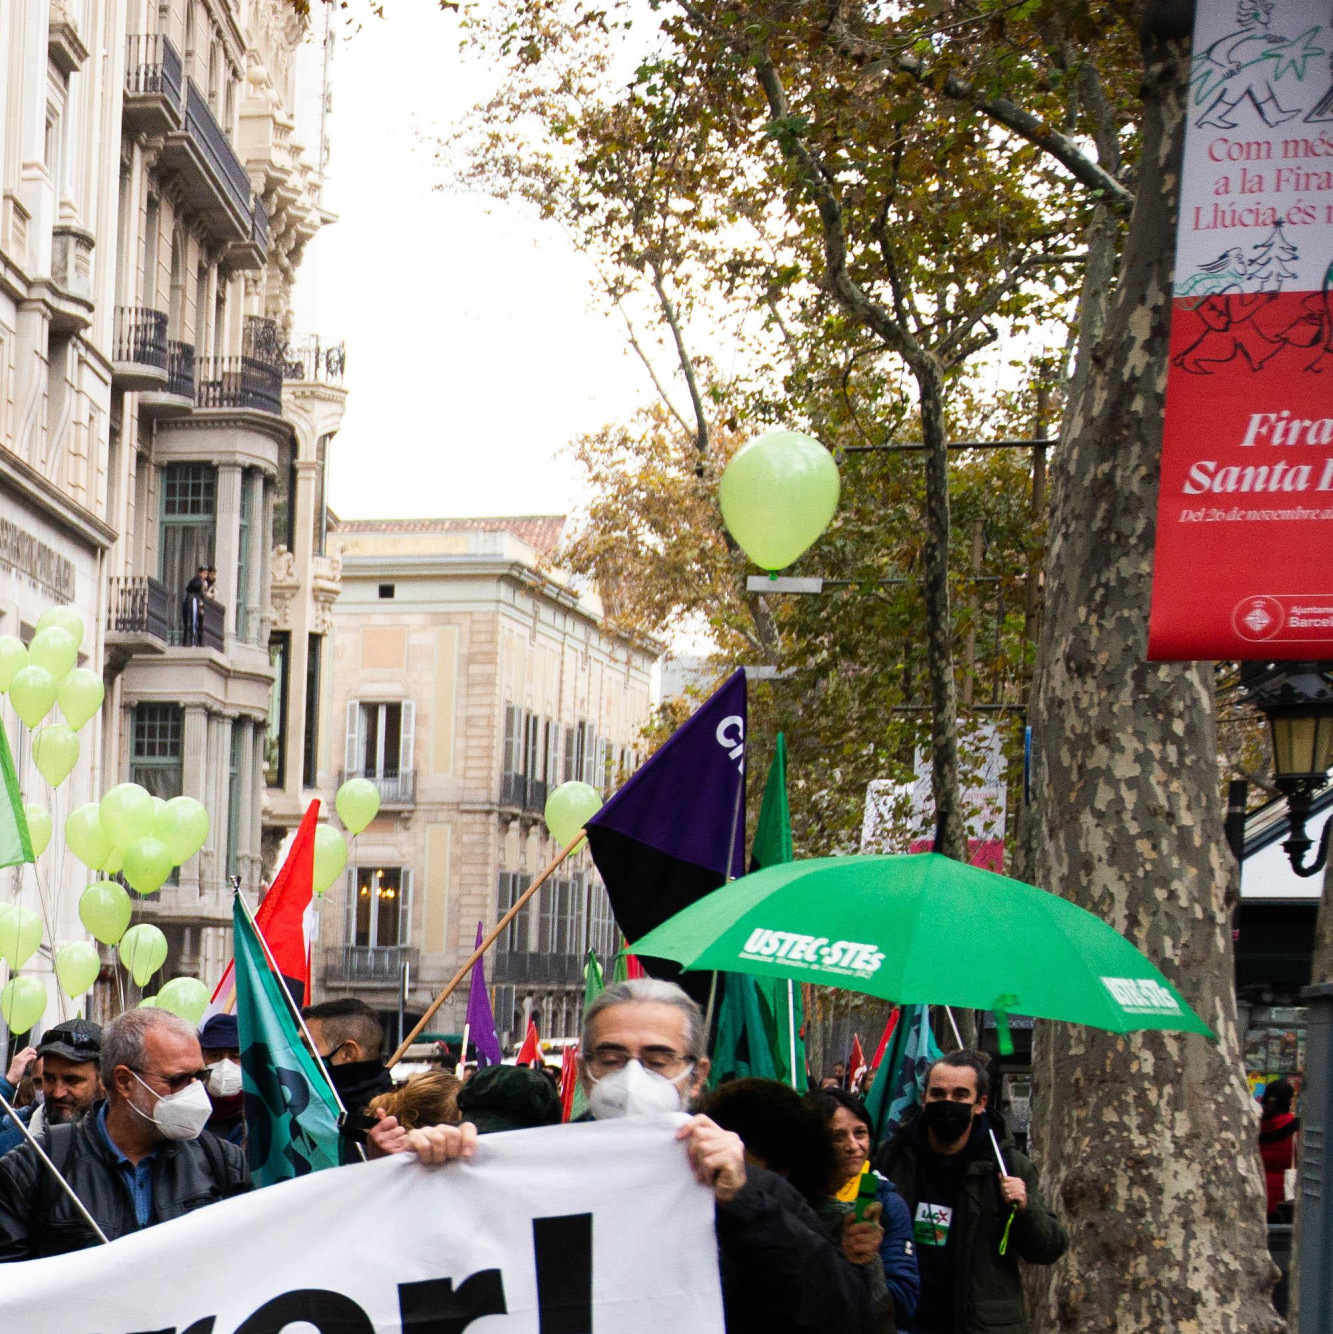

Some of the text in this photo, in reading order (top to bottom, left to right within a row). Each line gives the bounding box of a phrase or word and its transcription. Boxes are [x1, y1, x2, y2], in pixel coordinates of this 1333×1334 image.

[1208, 137, 1272, 162] Com
[1214, 166, 1333, 196] a la Fira
[1193, 201, 1278, 231] Llúcia
[1286, 199, 1316, 225] és
[1240, 410, 1333, 447] Fira
[1183, 460, 1313, 495] Santa
